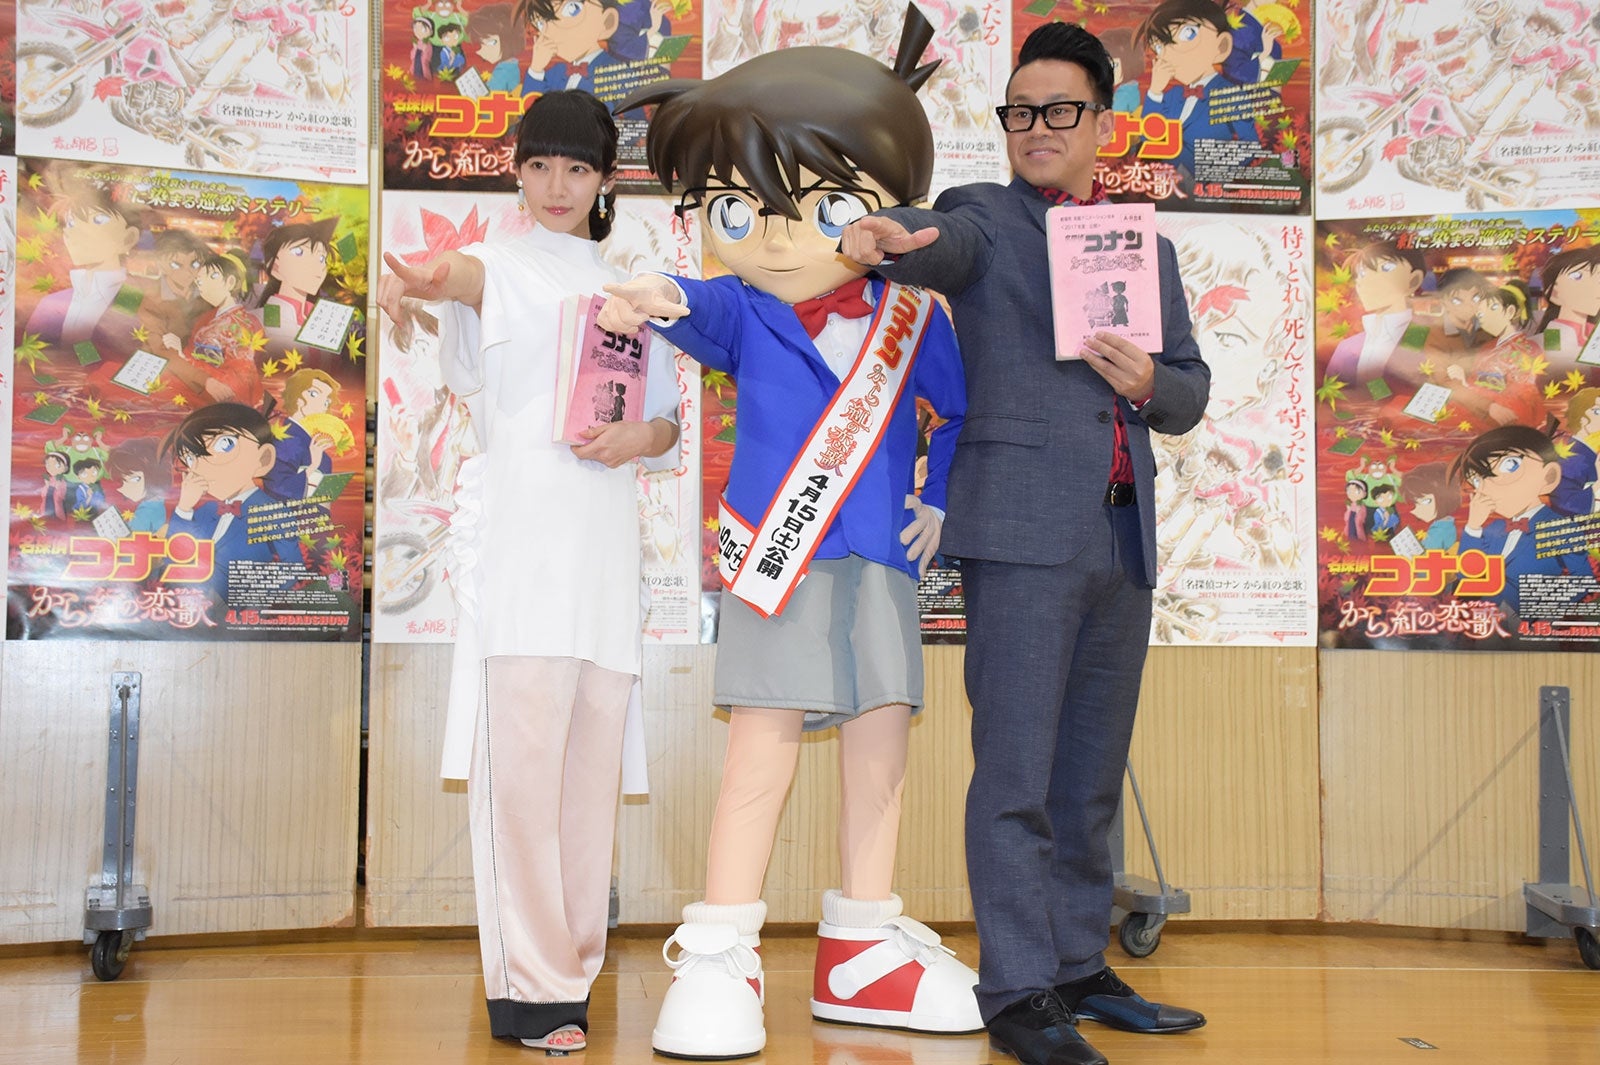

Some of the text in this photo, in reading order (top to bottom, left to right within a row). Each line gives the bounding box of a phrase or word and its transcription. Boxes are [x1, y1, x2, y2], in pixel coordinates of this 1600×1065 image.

[982, 0, 1001, 46] たる
[429, 91, 543, 137] コナ
[1083, 230, 1143, 252] コナン
[61, 531, 215, 583] コナン
[1364, 549, 1506, 596] コナン
[225, 609, 259, 626] 4.15
[1338, 601, 1511, 639] から紅の恋歌
[1518, 621, 1552, 636] 4.15
